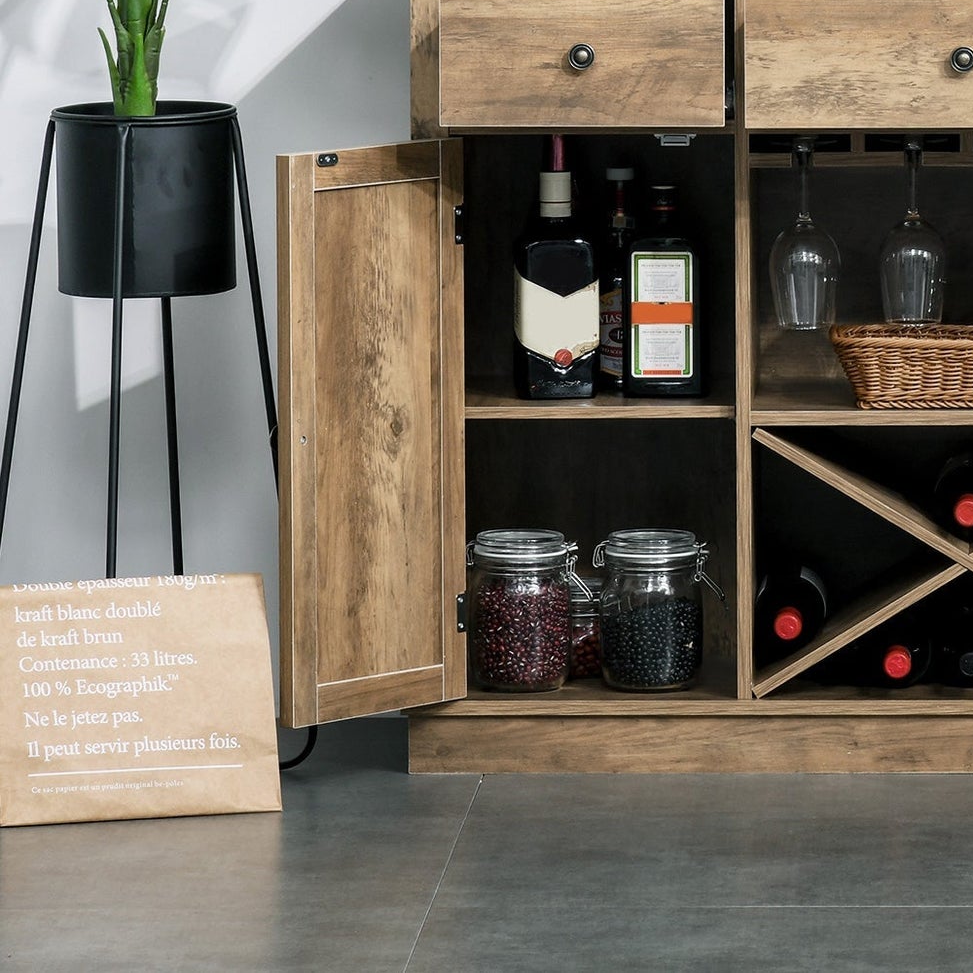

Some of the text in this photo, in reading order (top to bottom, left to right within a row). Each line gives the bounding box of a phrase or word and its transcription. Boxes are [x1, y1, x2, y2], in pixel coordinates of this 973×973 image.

[15, 601, 161, 623] kraft blanc doublé
[16, 628, 124, 647] de kraft brun
[19, 656, 118, 673] Contenance
[131, 652, 150, 667] 33
[153, 650, 198, 667] litres.
[23, 681, 51, 698] 100
[24, 710, 144, 730] Ne le jetez pas.
[27, 732, 242, 762] Il peut servir plusieurs fois.
